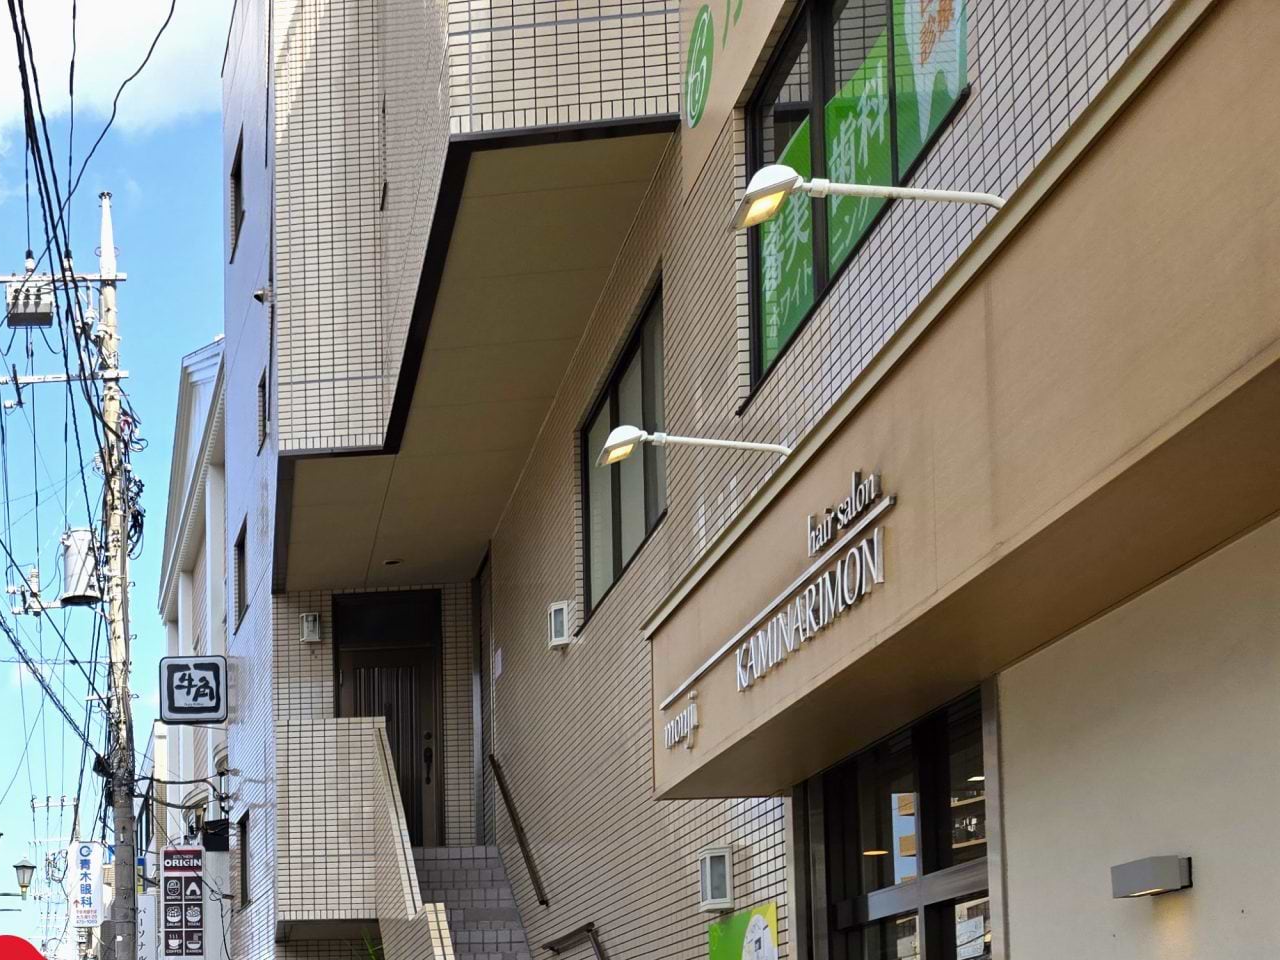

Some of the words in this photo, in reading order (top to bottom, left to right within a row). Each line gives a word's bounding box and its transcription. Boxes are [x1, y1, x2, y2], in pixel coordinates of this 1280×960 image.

[807, 508, 835, 558] hair
[836, 470, 883, 529] salon
[734, 526, 885, 692] KAMINARIMON
[175, 673, 215, 702] 牛角
[79, 858, 93, 908] 青木眼科
[164, 859, 202, 867] ORIGIN
